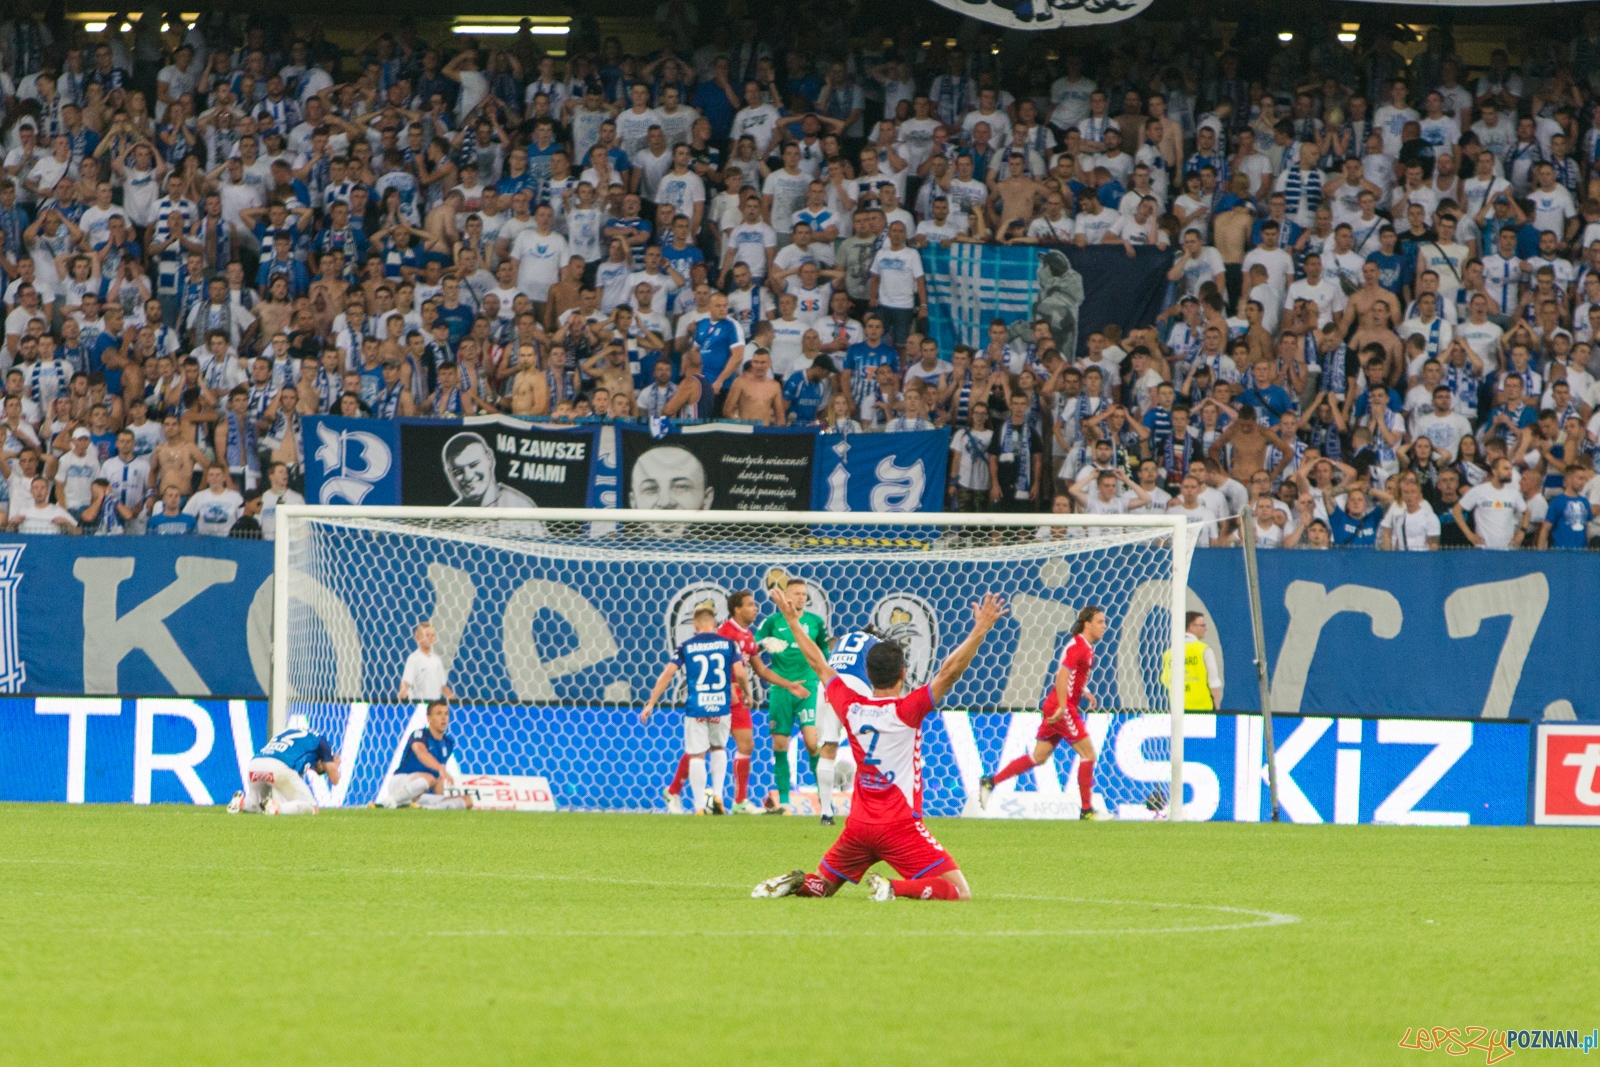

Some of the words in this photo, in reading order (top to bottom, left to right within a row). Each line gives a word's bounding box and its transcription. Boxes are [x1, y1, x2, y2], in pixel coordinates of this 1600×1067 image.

[801, 299, 820, 312] STS
[496, 433, 516, 454] NA
[519, 438, 586, 460] ZAWSZE
[508, 460, 521, 478] Z
[522, 462, 567, 483] NAMI
[838, 631, 870, 652] 13
[832, 654, 854, 662] LECH
[692, 652, 727, 692] 23
[701, 695, 724, 703] LECH
[859, 724, 882, 765] 2
